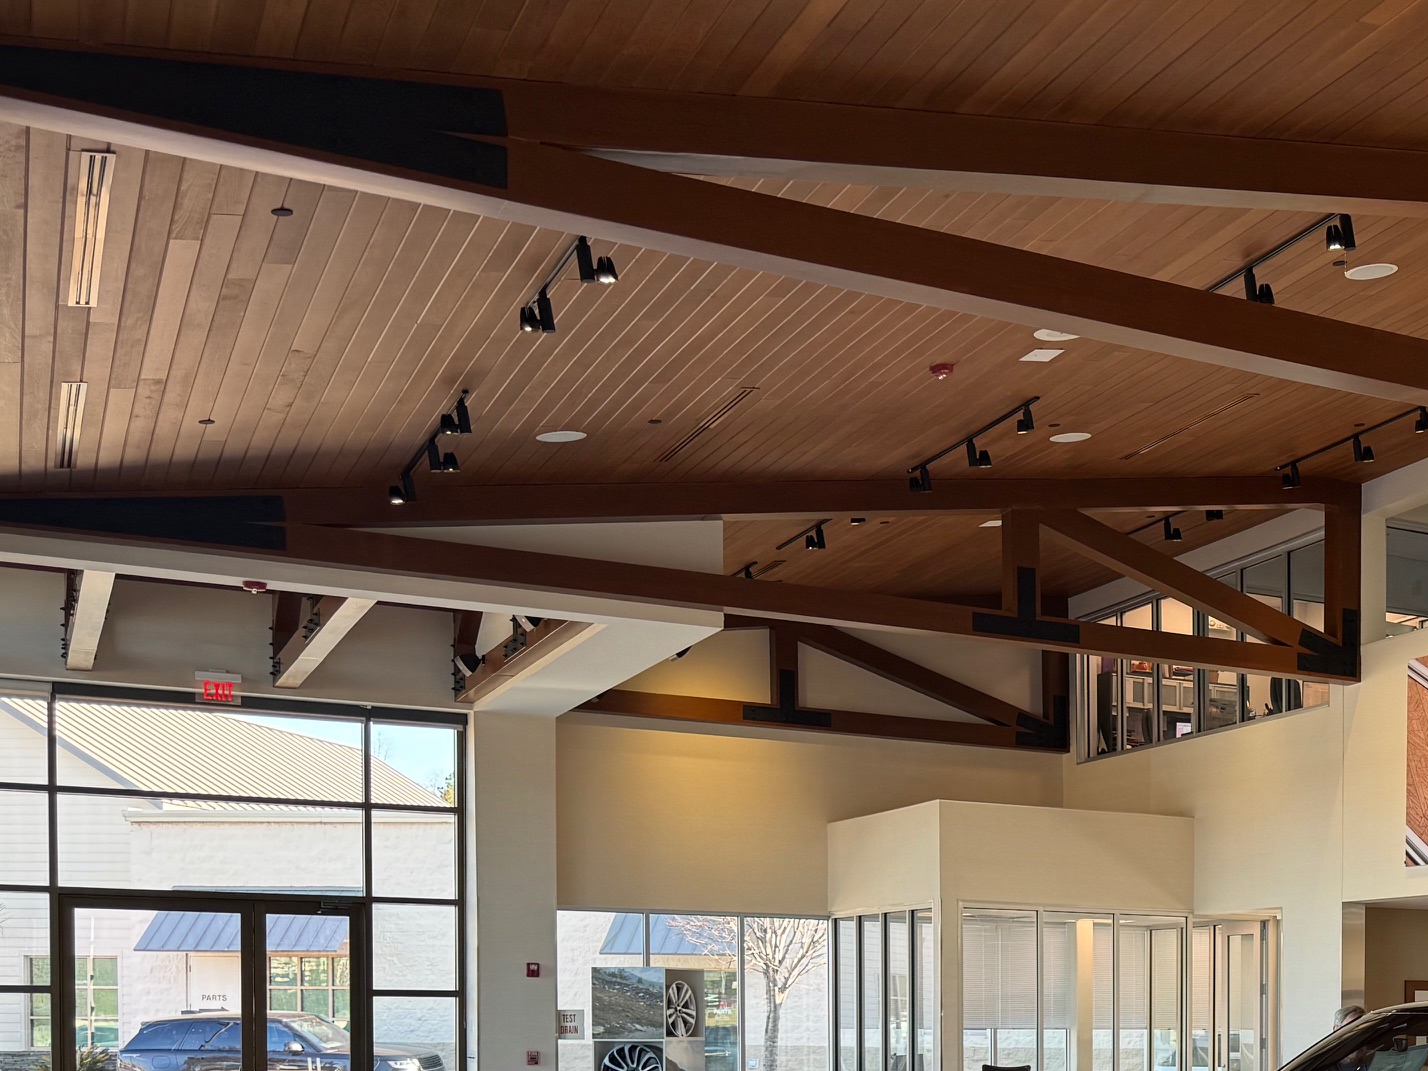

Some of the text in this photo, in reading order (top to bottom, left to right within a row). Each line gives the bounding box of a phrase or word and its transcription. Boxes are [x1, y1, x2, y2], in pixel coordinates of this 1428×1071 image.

[203, 680, 234, 702] EXIT
[562, 1013, 577, 1023] TEST
[560, 1025, 578, 1034] DRAIN
